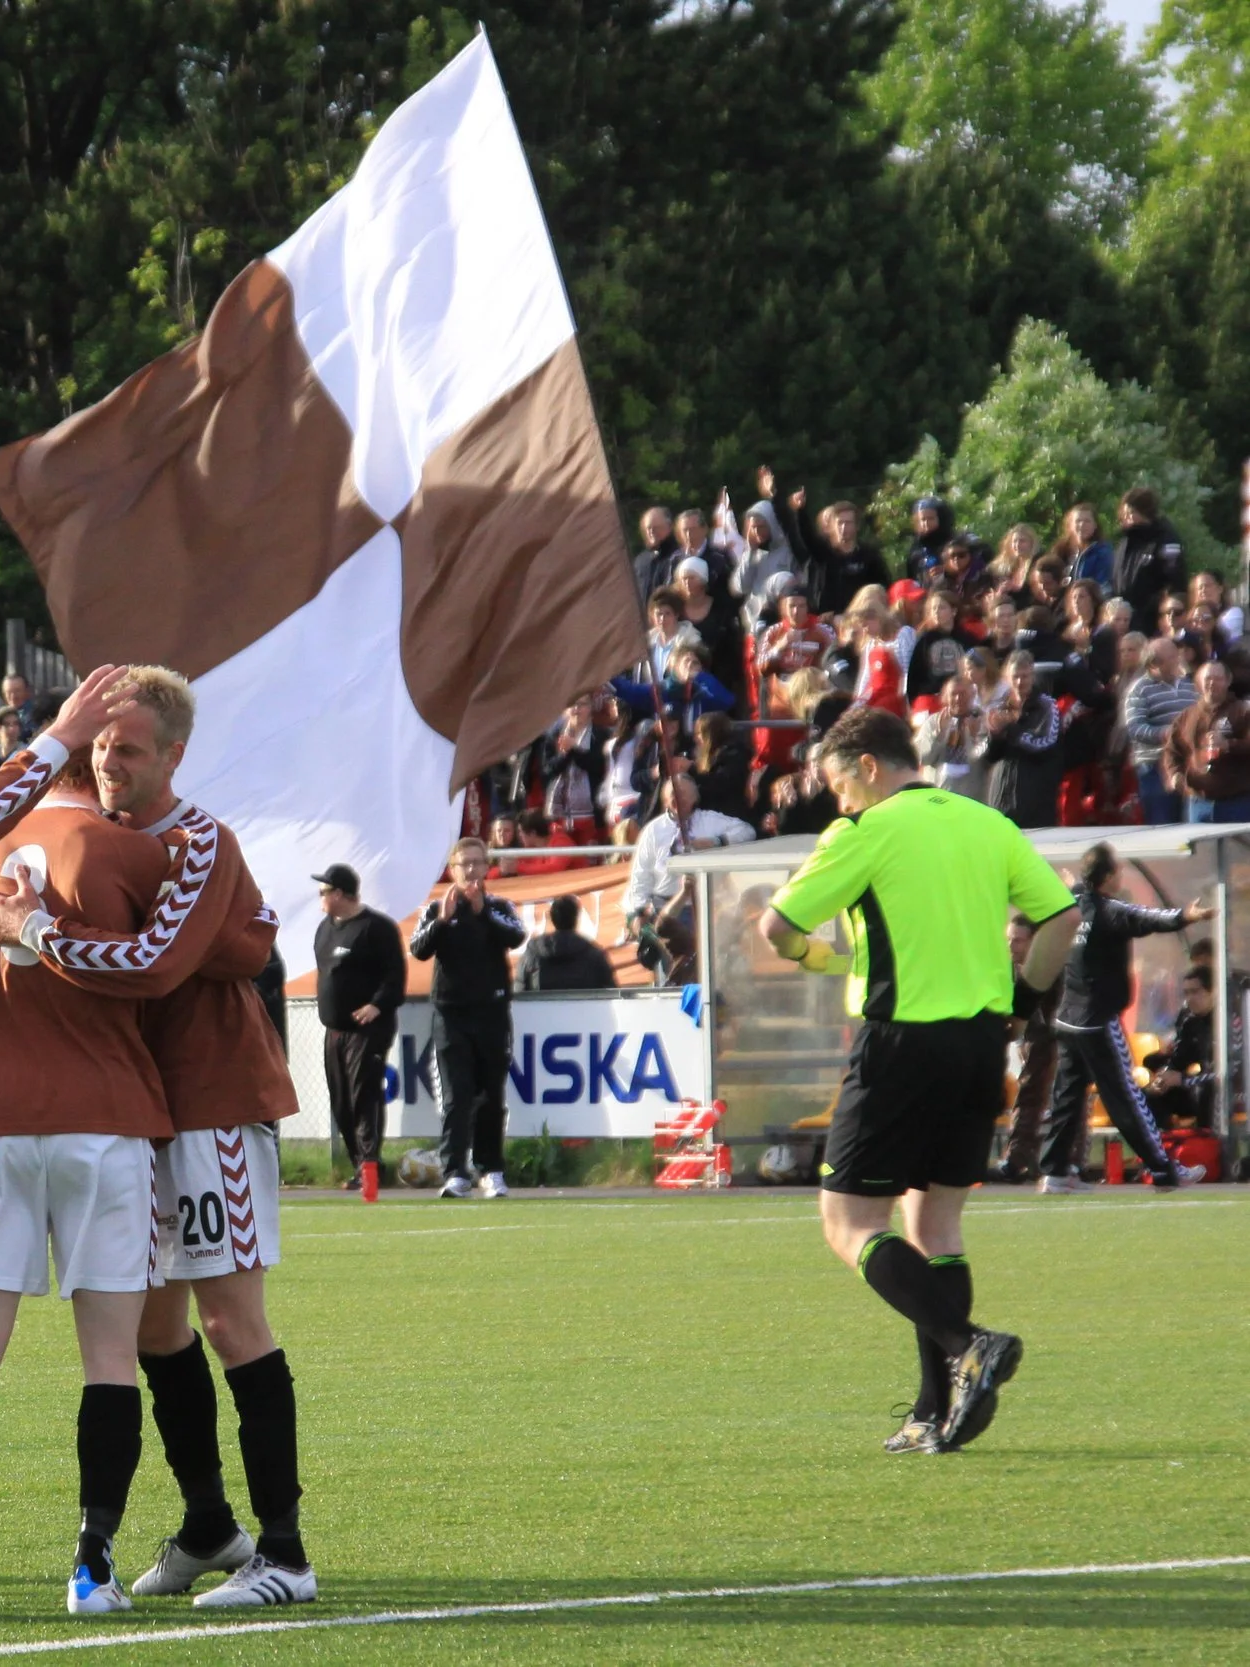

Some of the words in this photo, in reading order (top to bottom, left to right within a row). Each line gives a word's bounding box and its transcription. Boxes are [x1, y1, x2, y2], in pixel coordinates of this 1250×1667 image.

[384, 1032, 682, 1105] KNSKA
[178, 1191, 225, 1246] 20
[184, 1246, 224, 1259] hummel
